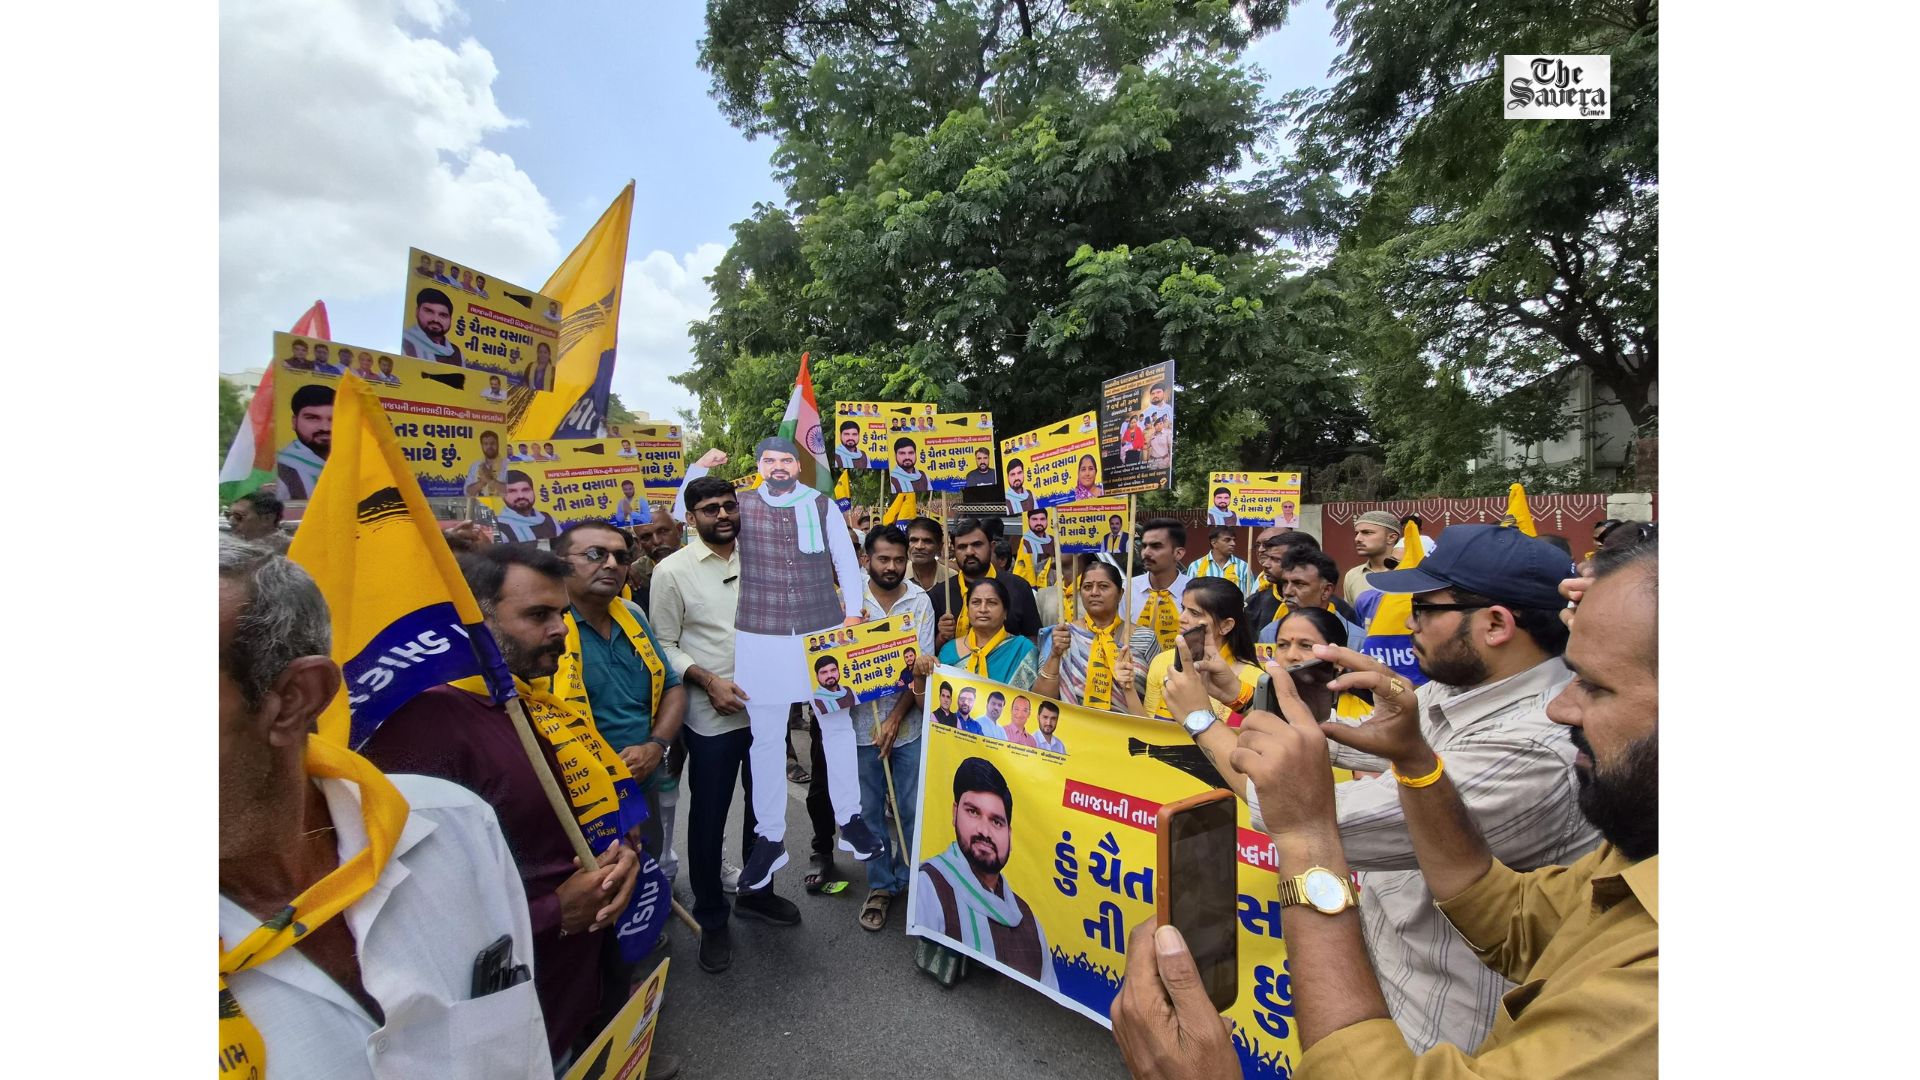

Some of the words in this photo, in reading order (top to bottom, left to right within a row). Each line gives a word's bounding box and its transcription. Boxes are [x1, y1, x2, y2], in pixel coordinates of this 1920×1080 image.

[422, 424, 473, 439] વસાવા
[1070, 790, 1129, 820] ભાજપની
[1053, 830, 1078, 897] હું
[1088, 831, 1154, 905] ચૈત
[1083, 900, 1126, 955] ની
